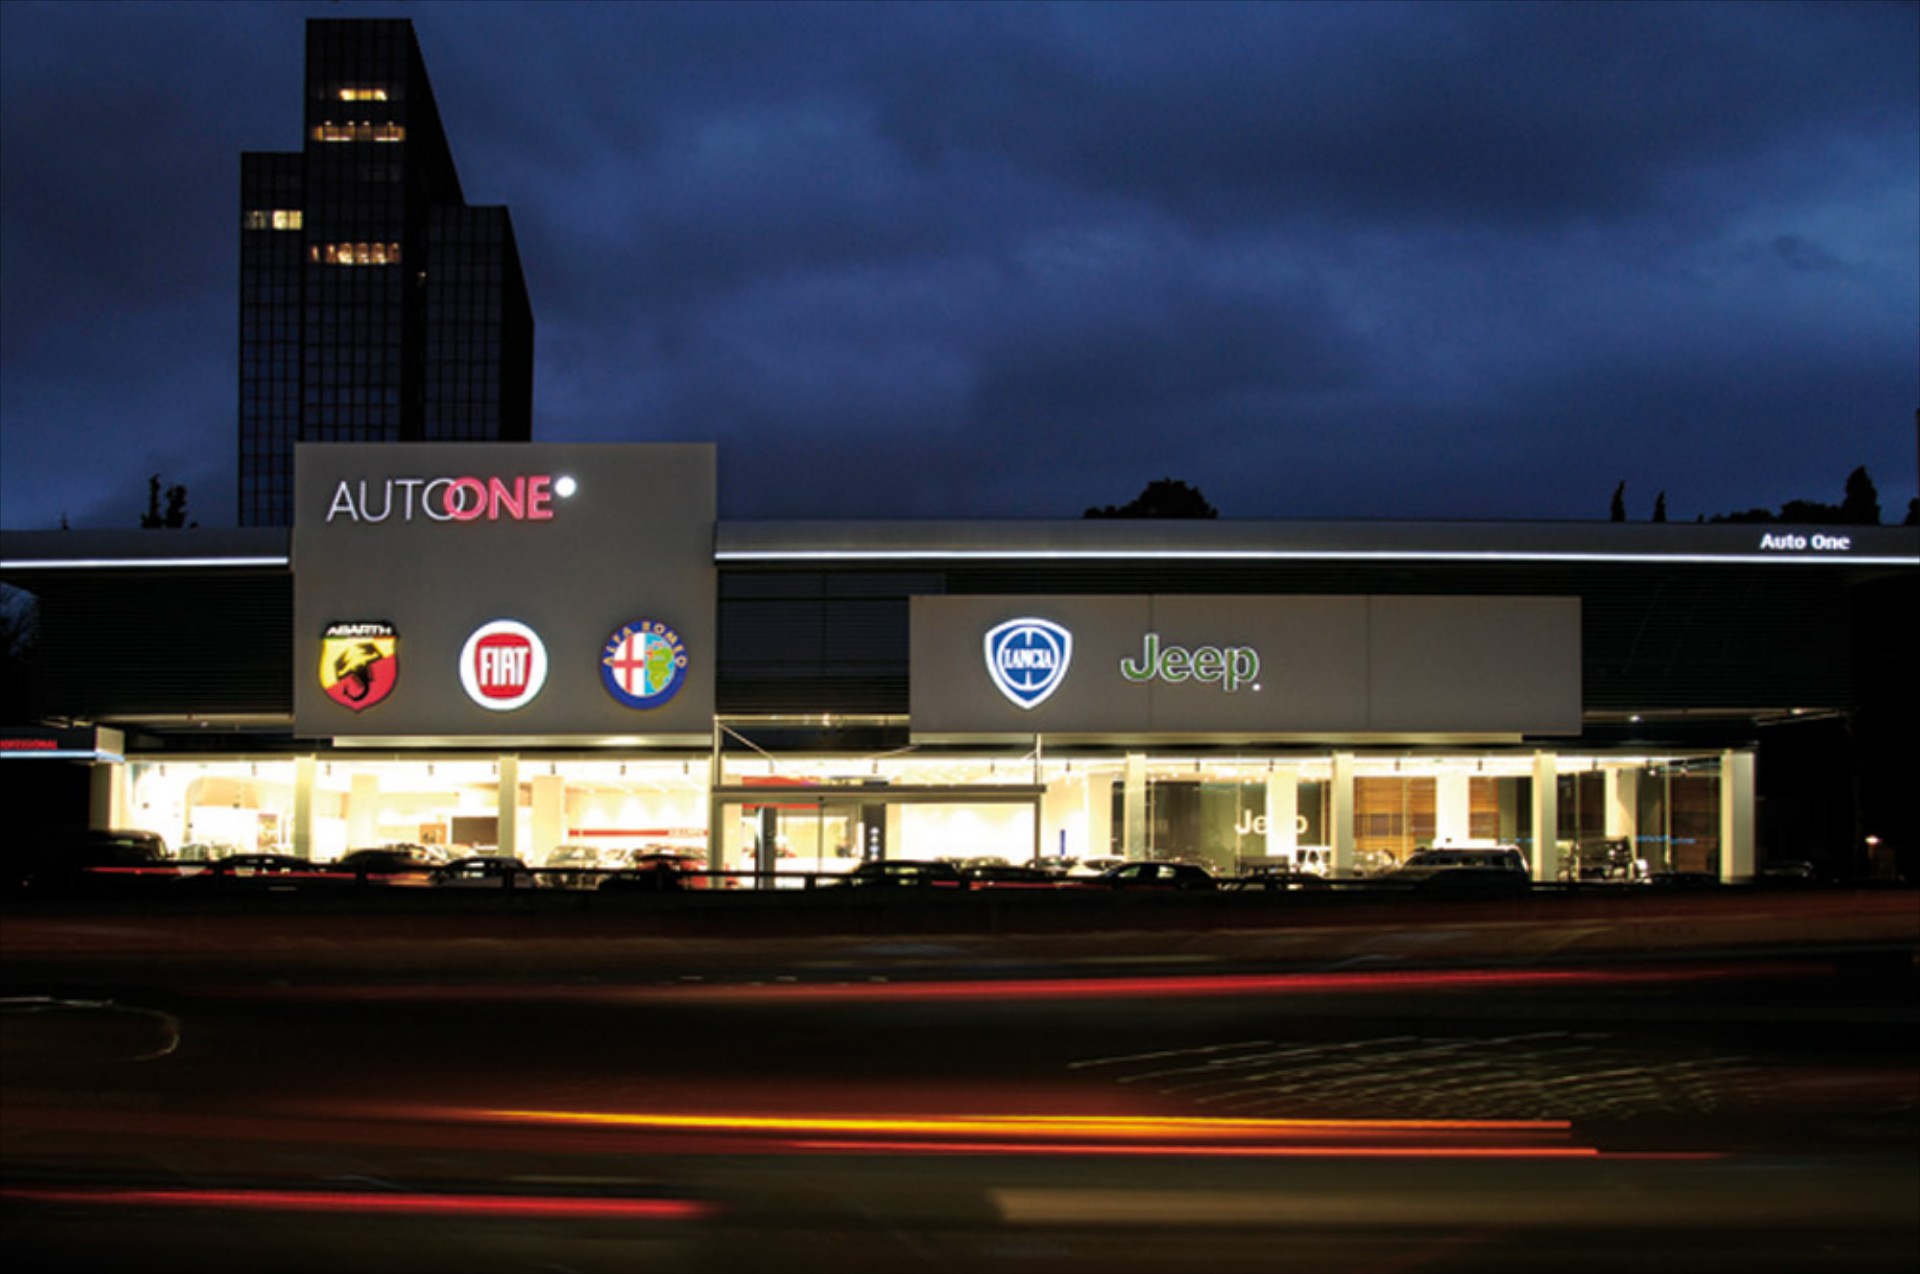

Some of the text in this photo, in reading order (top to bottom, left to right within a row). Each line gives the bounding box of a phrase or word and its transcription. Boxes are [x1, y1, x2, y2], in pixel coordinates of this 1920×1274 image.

[1760, 533, 1850, 549] Auto One
[326, 624, 392, 636] ABARTH
[603, 621, 687, 668] ALFA ROMEO
[481, 646, 529, 686] FIAT
[1004, 648, 1053, 668] LANCIA
[1121, 633, 1260, 691] Jeep
